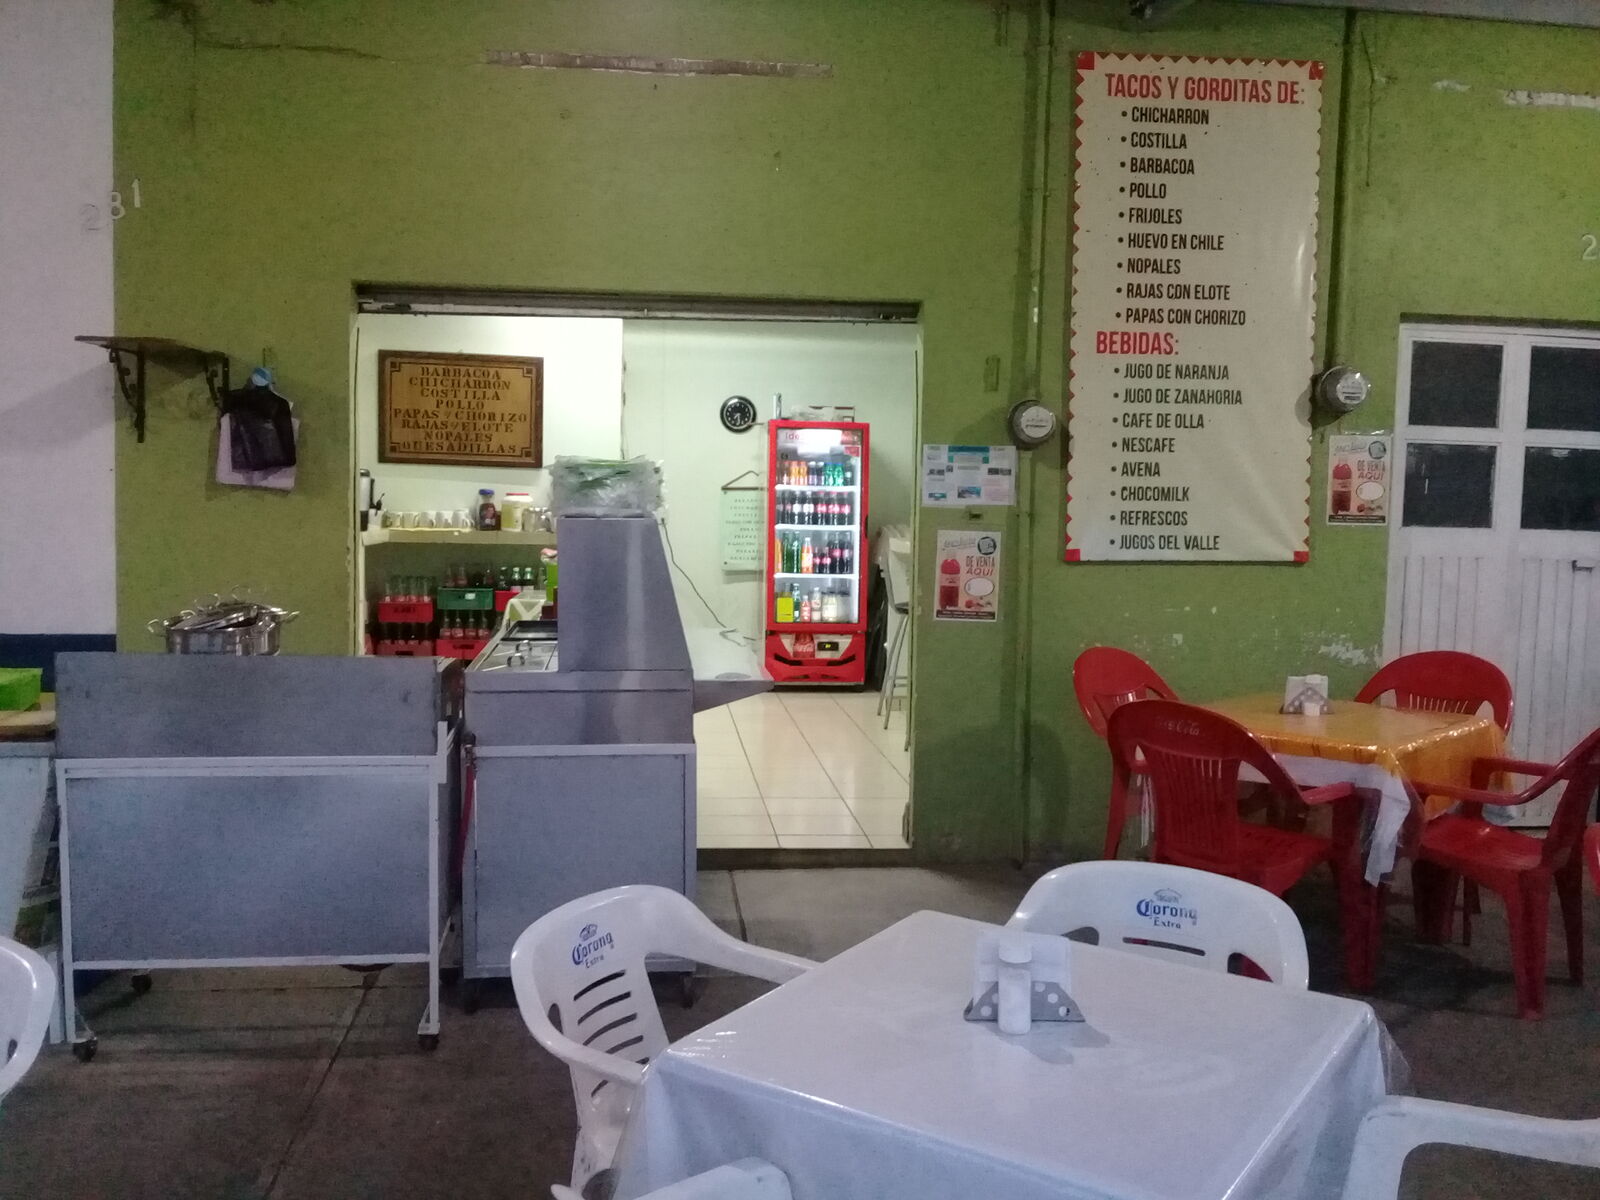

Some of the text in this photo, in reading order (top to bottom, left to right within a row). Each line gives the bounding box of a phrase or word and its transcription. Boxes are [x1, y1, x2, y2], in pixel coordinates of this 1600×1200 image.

[1105, 73, 1305, 105] TACOS Y GORDITAS DE:
[1131, 106, 1210, 125] CHICHARRON
[1131, 132, 1187, 149] COSTILLA
[1130, 157, 1195, 175] BARBACOA
[1129, 182, 1167, 199] POLLO
[1128, 208, 1183, 224] FRIJOLES
[1128, 233, 1224, 251] HUEVO EN CHILE
[1127, 258, 1181, 274] NOPALES
[1126, 283, 1230, 300] RAJAS CON ELOTE
[1126, 308, 1246, 326] PAPAS CON CHORIZO
[1096, 331, 1179, 355] BEBIDAS:
[420, 366, 501, 380] BARBACOA
[1124, 364, 1229, 381] JUGO DE NARANJA
[409, 377, 511, 390] CHICHARRON
[420, 388, 501, 401] COSTILLA
[1123, 388, 1243, 405] JUGO DE ZANAHORIA
[435, 400, 484, 410] POLLO
[393, 408, 440, 419] PAPAS
[1122, 413, 1204, 429] CAFE DE OLLA
[401, 419, 449, 430] RAJAS
[424, 431, 493, 442] NOPALES
[402, 441, 517, 454] QUESADILLAS
[1122, 437, 1176, 453] NESCAFE
[1121, 462, 1161, 477] AVENA
[1120, 486, 1190, 501] CHOCOMILK
[1120, 511, 1188, 526] REFRESCOS
[1119, 535, 1220, 550] JUGOS DEL VALLE
[965, 555, 995, 568] DE VENTA
[1136, 898, 1197, 925] Corona
[1153, 918, 1181, 929] Extra
[572, 932, 614, 965] Corona
